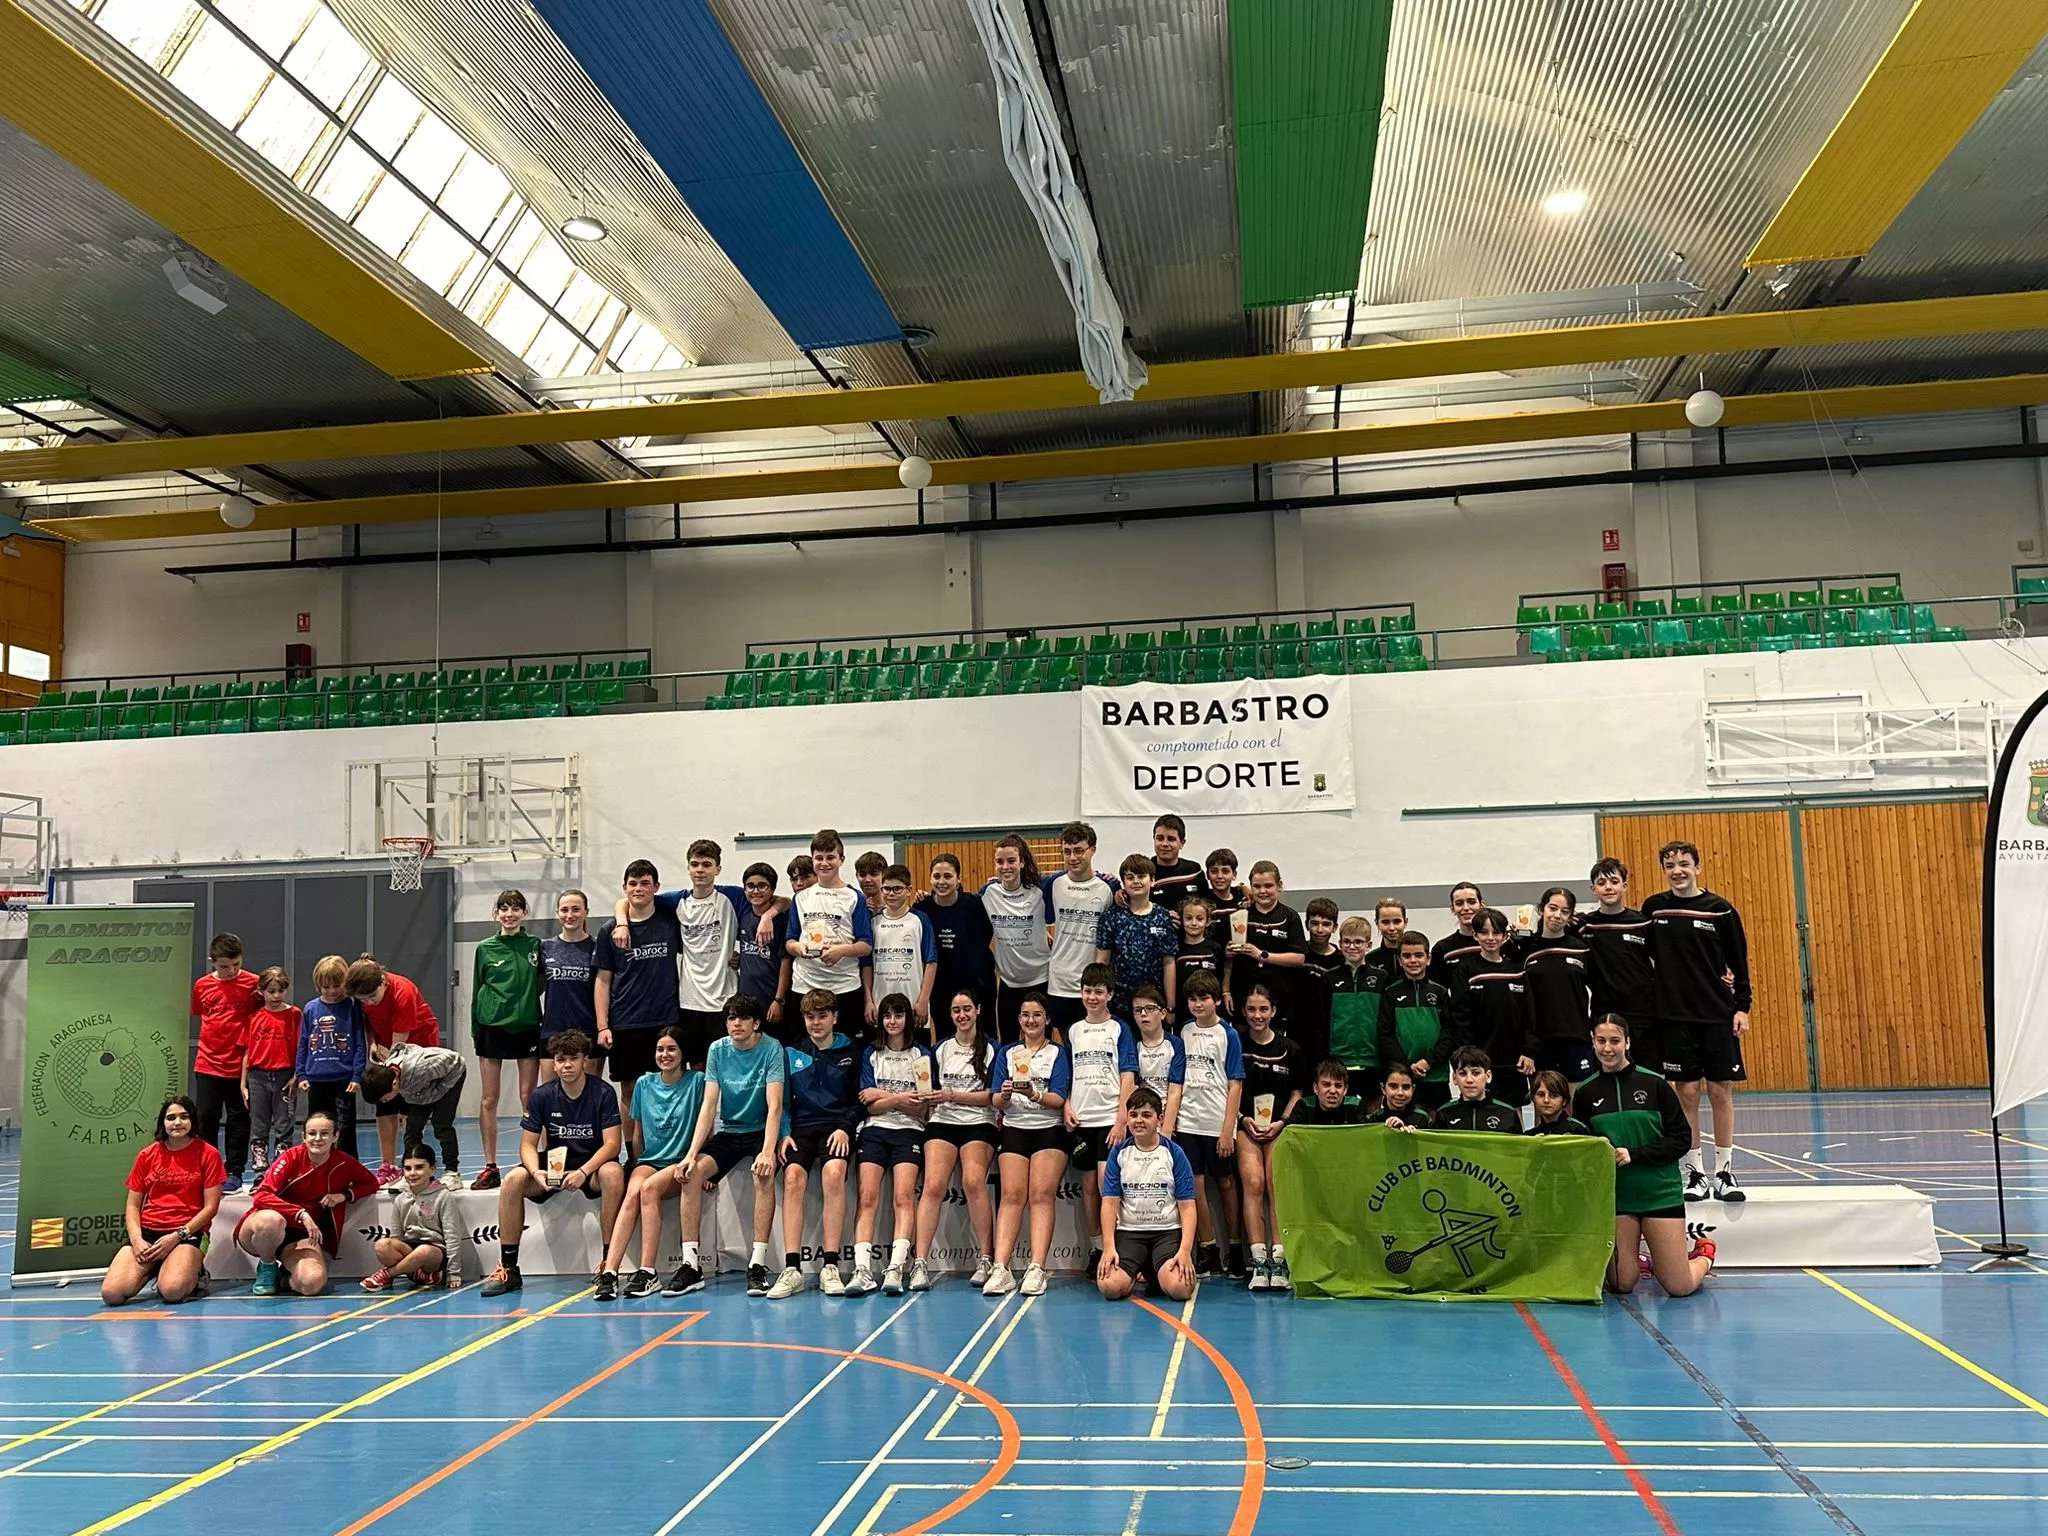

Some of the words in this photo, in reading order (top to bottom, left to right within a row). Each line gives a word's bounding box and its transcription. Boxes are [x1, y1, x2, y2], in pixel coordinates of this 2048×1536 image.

[1102, 693, 1329, 726] BARBASTRO
[1146, 729, 1238, 757] comprometido
[1242, 739, 1265, 749] con
[1270, 728, 1282, 748] el
[1133, 760, 1300, 790] DEPORTE
[1999, 839, 2048, 850] BARB
[29, 922, 192, 938] BADMINTON
[45, 946, 173, 964] ARAGON
[633, 946, 668, 957] Daroca
[553, 967, 590, 979] Daroca
[32, 1051, 50, 1117] FEDERACION
[49, 1013, 113, 1049] ARAGONESA
[150, 1030, 166, 1046] DE
[160, 1045, 179, 1101] BADMINTO
[558, 1126, 593, 1136] Daroca
[1368, 1171, 1399, 1213] CLUB
[1397, 1159, 1423, 1179] DE
[1425, 1156, 1522, 1218] BADMINTON
[65, 1231, 89, 1246] DE
[95, 1230, 131, 1245] ARA
[1053, 1246, 1082, 1258] con
